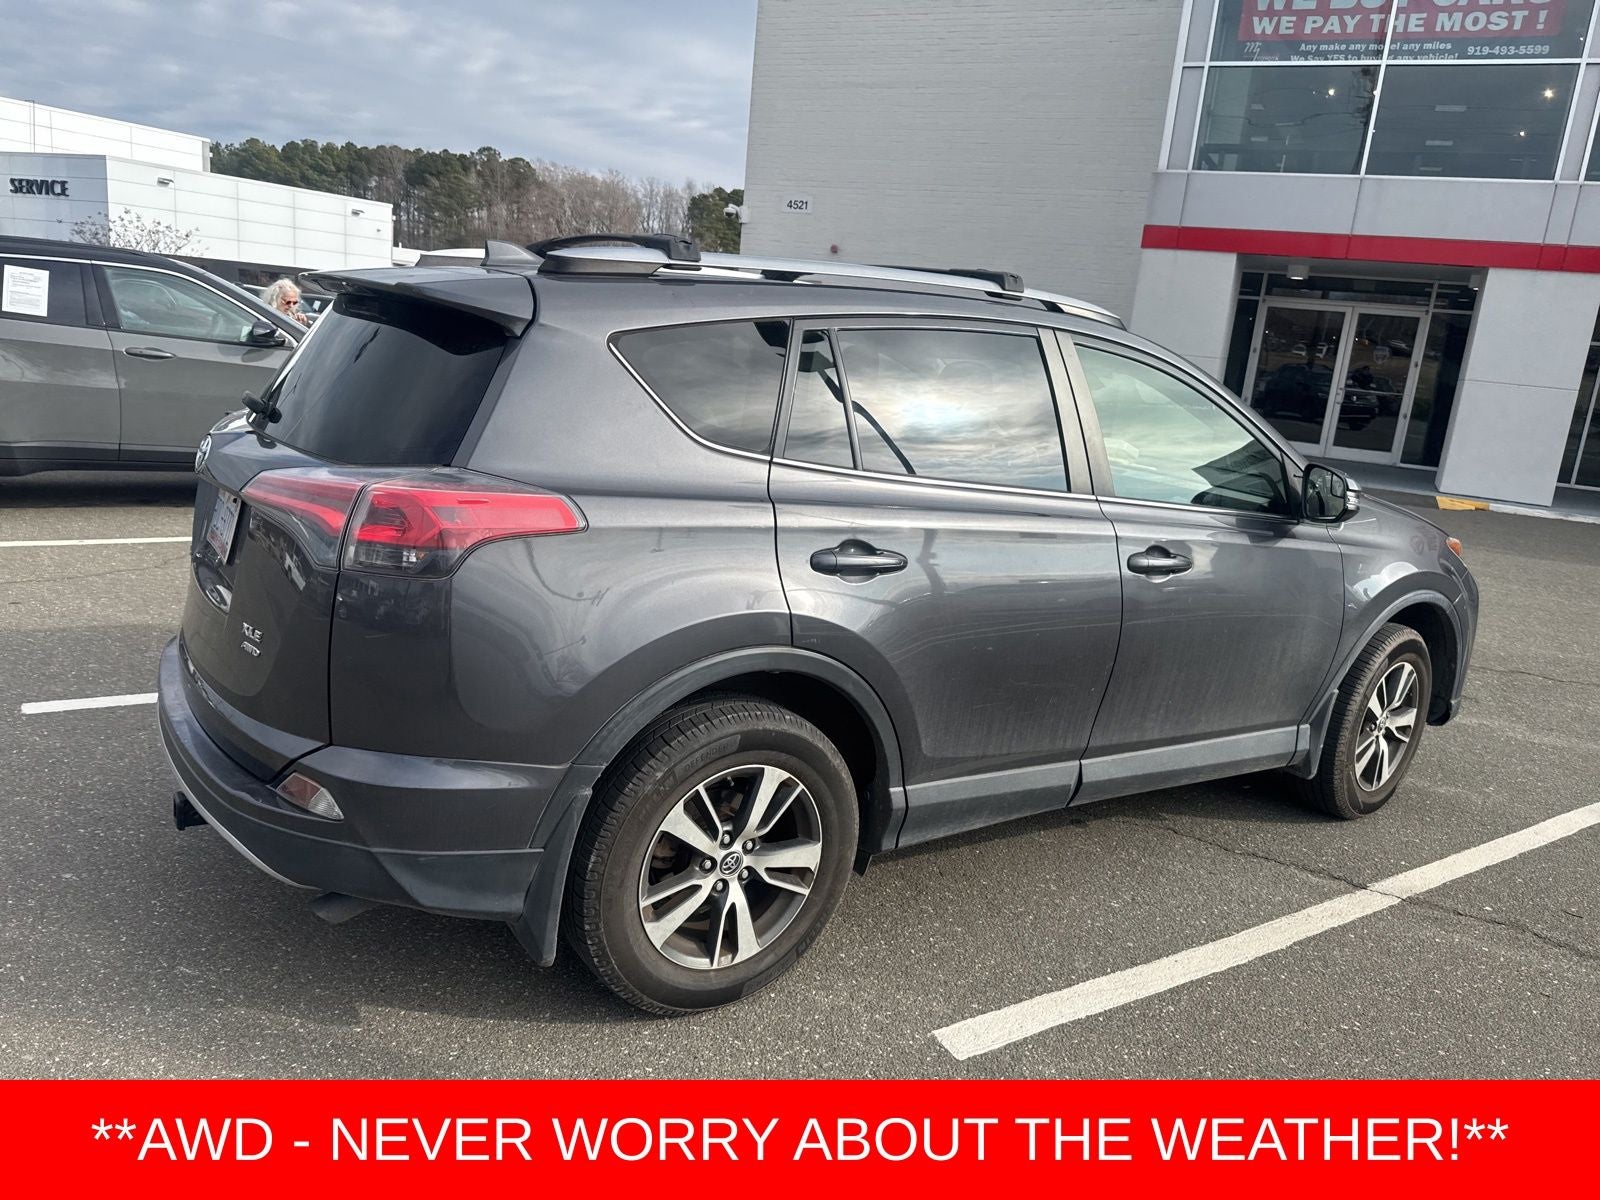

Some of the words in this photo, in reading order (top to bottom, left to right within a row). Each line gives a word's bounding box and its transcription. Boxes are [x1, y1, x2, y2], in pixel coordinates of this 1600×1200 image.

[1252, 16, 1297, 35] WE
[1303, 14, 1363, 34] PAY
[1369, 13, 1427, 33] THE
[1435, 10, 1529, 32] MOST
[1299, 43, 1318, 52] Any
[1319, 43, 1346, 51] make
[1348, 43, 1367, 52] any
[1368, 42, 1400, 51] moel
[1402, 42, 1421, 51] any
[1423, 41, 1452, 50] miles
[1467, 45, 1550, 56] 919-493-5599
[9, 177, 70, 197] SERVICE
[786, 199, 808, 210] 4521
[242, 621, 263, 642] XLE
